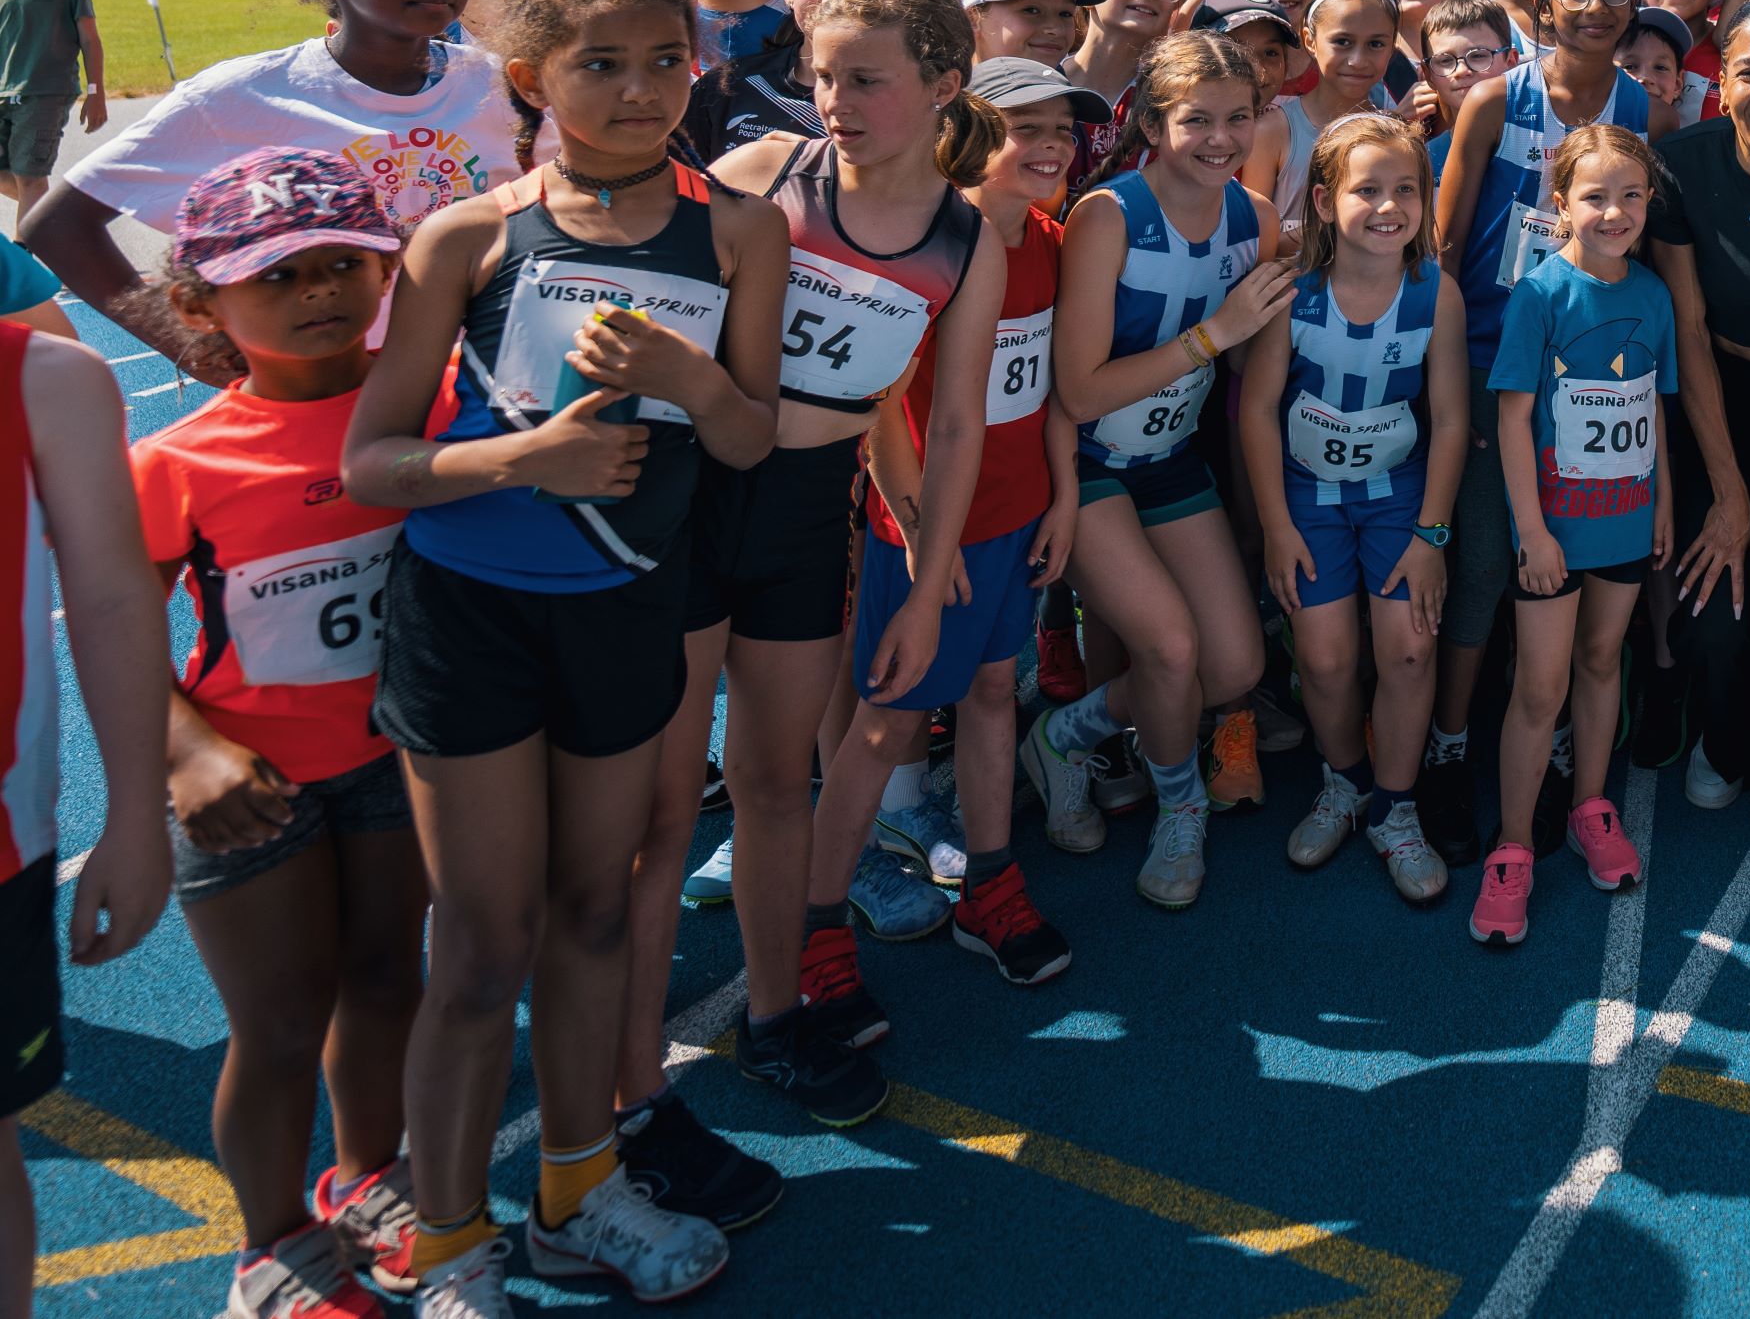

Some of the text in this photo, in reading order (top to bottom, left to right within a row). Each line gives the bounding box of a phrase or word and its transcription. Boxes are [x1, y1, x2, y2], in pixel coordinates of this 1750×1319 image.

[1514, 114, 1537, 122] START
[388, 127, 471, 162] LOVE
[367, 150, 421, 185] LOVE
[419, 167, 452, 194] LOVE
[426, 152, 470, 194] LOVE
[243, 173, 340, 218] NY
[1137, 235, 1161, 245] START
[634, 296, 712, 320] SPRINT
[841, 293, 917, 320] SPRINT
[1297, 308, 1320, 316] START
[782, 309, 857, 370] 54
[1003, 354, 1040, 395] 81
[1143, 400, 1190, 436] 86
[1351, 418, 1402, 434] SPRINT
[1583, 416, 1648, 453] 200
[1323, 438, 1374, 468] 85
